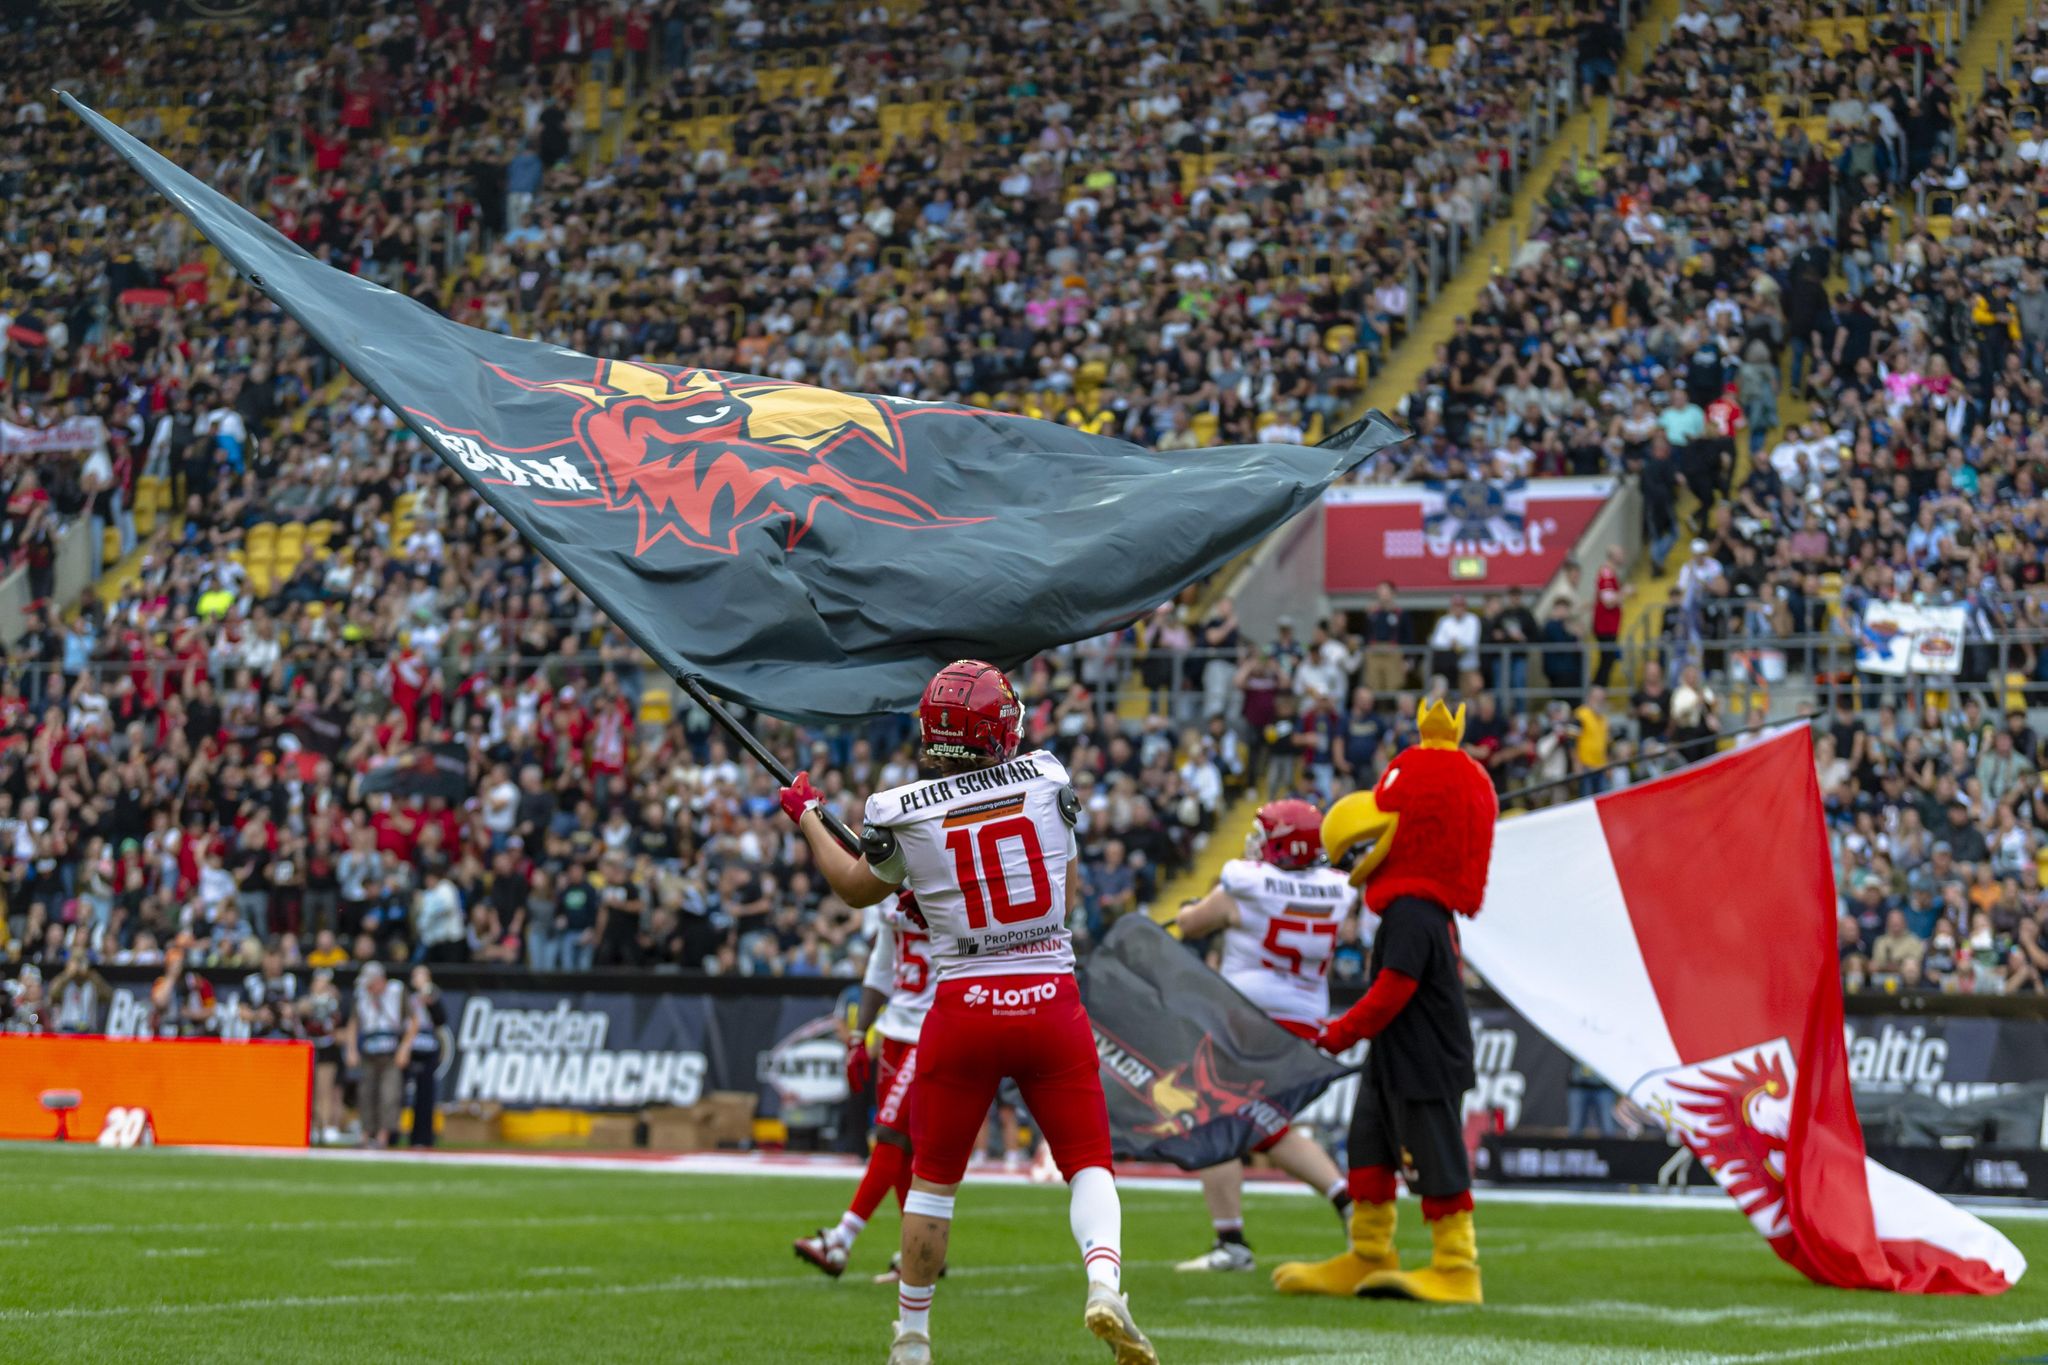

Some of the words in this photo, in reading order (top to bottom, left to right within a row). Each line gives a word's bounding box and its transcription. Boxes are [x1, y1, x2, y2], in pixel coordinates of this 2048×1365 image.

[900, 781, 953, 814] PETER
[956, 760, 1044, 795] SCHWARZ
[945, 816, 1052, 929] 10
[1262, 917, 1338, 976] 57
[993, 982, 1057, 1006] LOTTO
[457, 996, 610, 1050] Dresden
[454, 1050, 708, 1107] MONARCHS
[97, 1106, 146, 1148] 20
